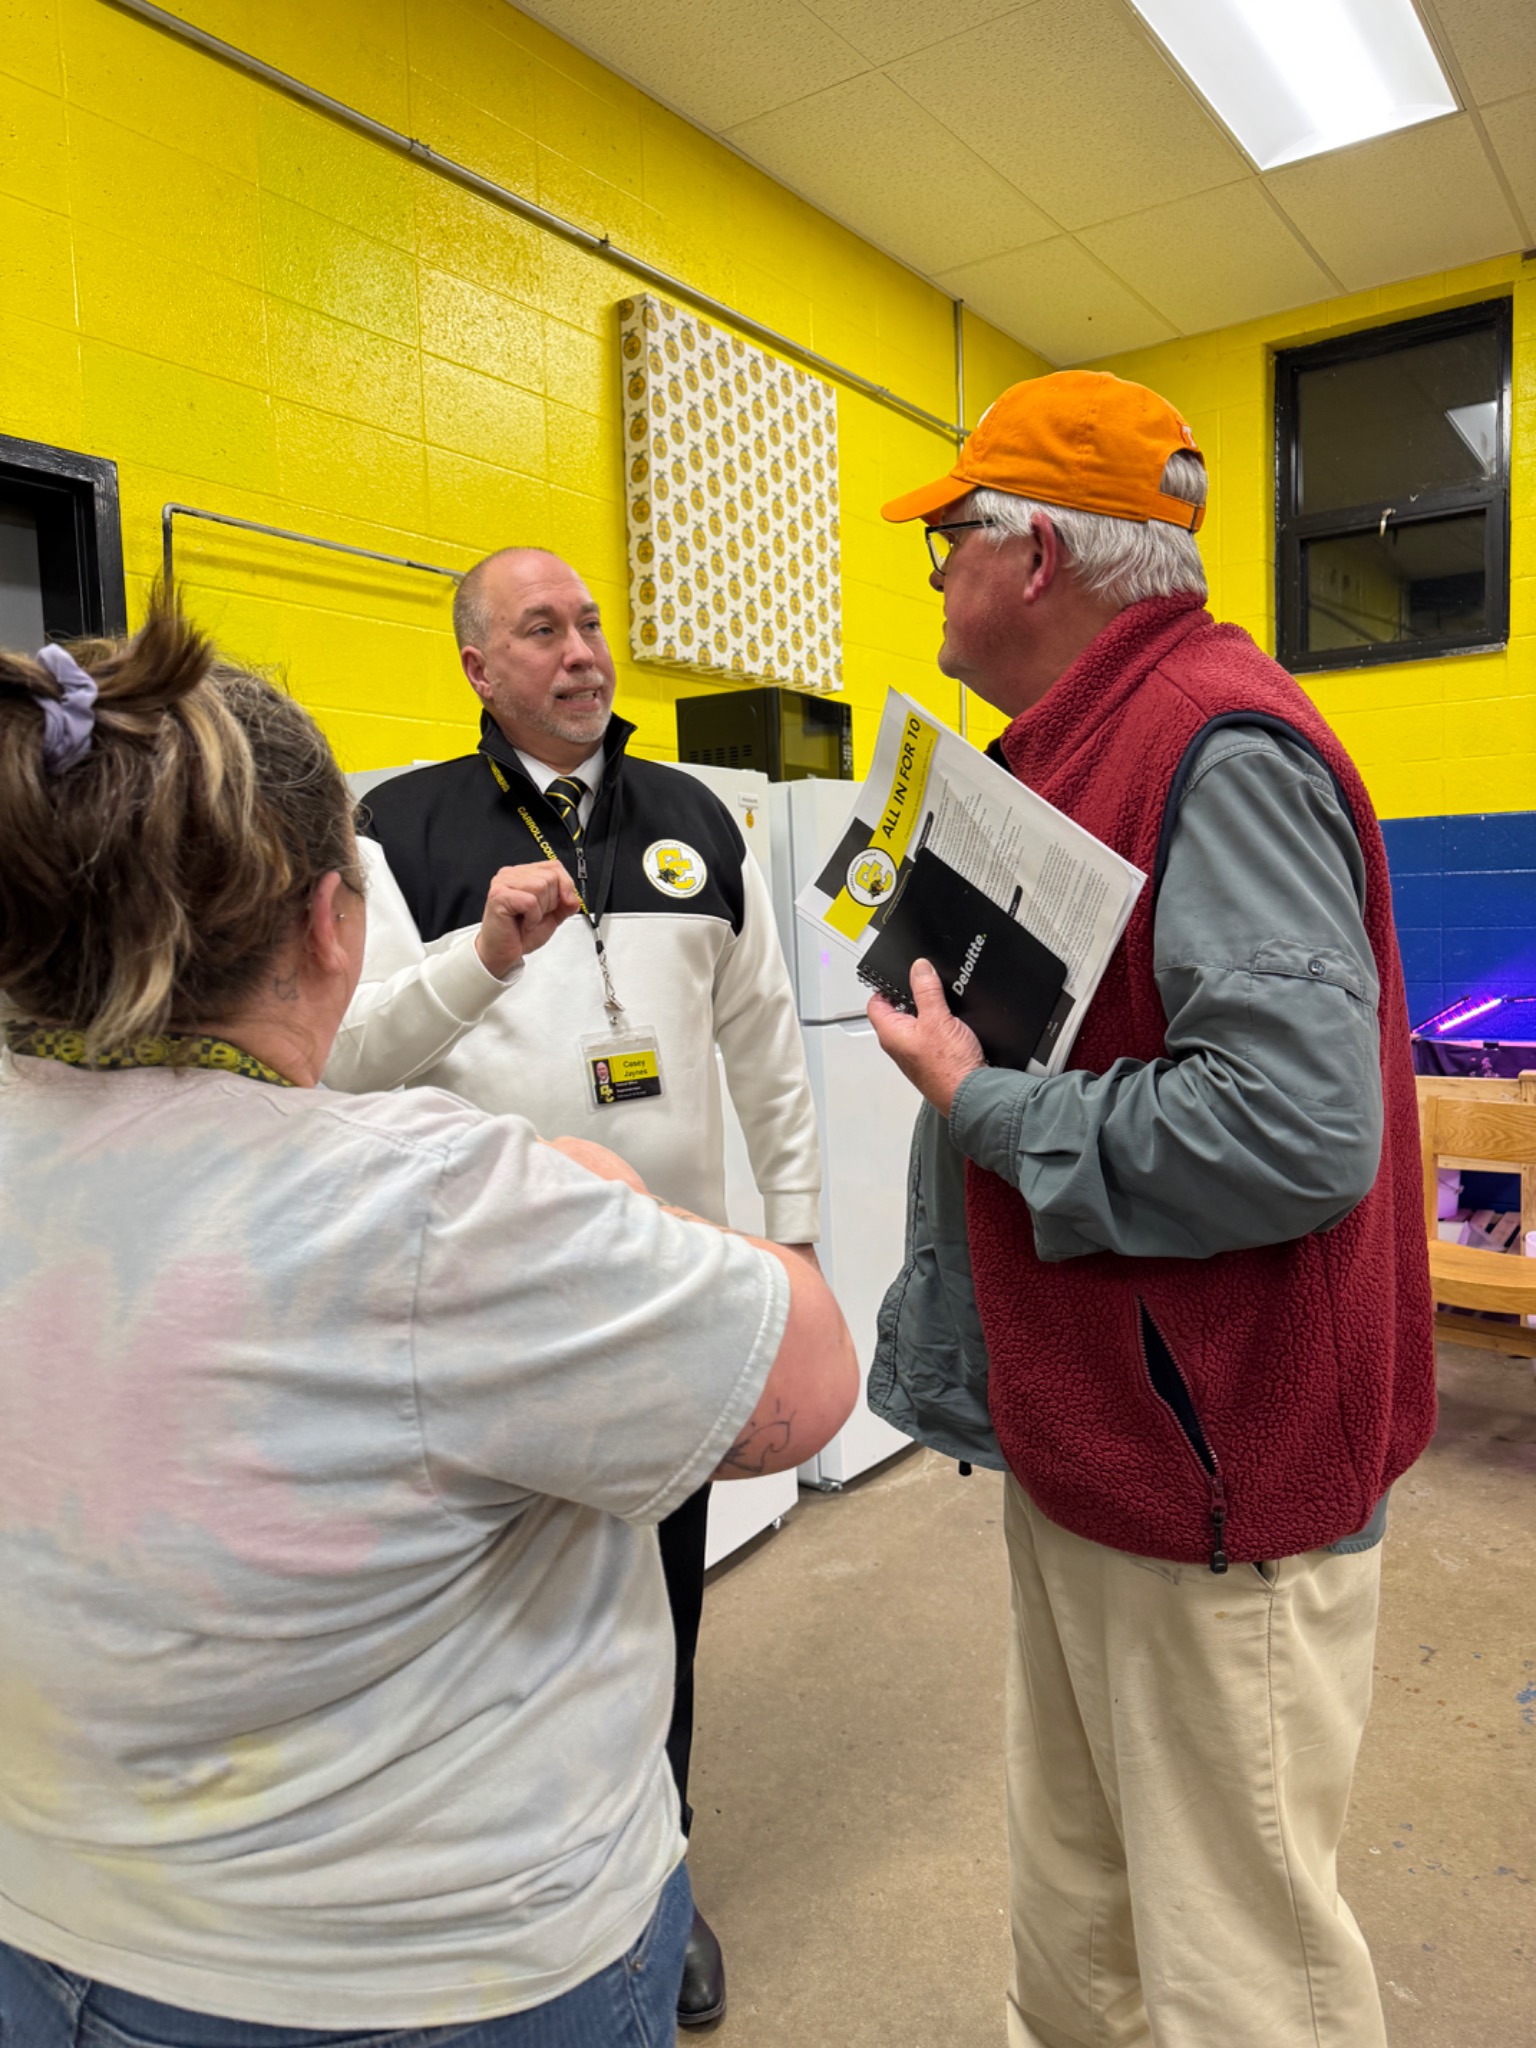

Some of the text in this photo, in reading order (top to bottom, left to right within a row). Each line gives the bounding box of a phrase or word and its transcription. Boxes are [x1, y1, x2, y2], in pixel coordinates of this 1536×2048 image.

[908, 718, 921, 739] 10
[899, 743, 916, 781] FOR
[893, 782, 907, 806] IN
[517, 806, 544, 843] CARROLL
[882, 808, 901, 839] ALL
[623, 1060, 646, 1069] Casey
[624, 1069, 649, 1078] Jaynes
